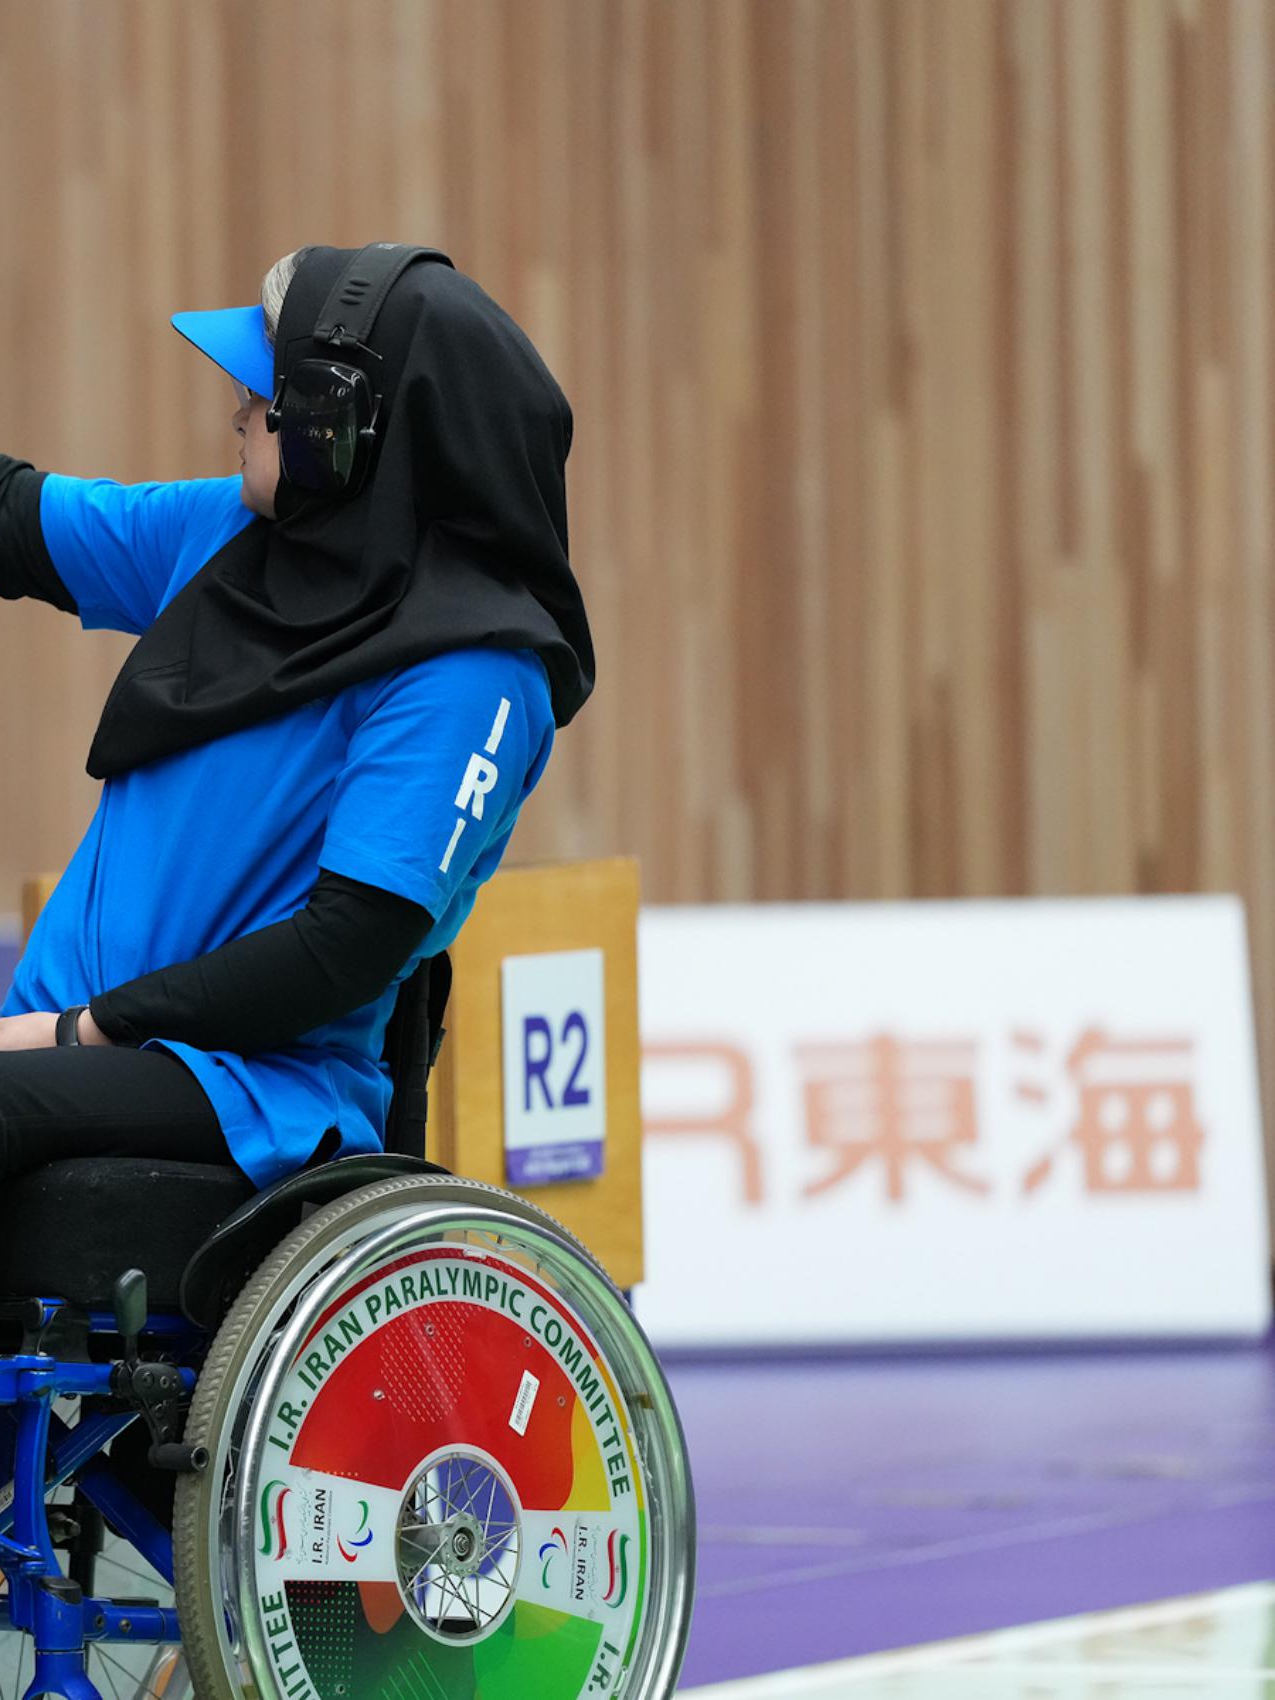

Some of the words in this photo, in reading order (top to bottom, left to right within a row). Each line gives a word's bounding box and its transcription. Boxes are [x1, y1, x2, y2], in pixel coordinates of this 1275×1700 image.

[522, 1010, 591, 1112] R2
[269, 1400, 307, 1451] I.R.
[297, 1311, 364, 1391] IRAN
[365, 1267, 525, 1324] PARALYMPIC
[530, 1305, 631, 1498] COMMITTEE
[313, 1488, 326, 1531] IRAN
[311, 1537, 324, 1564] I.R.
[577, 1526, 588, 1552] I.R.
[575, 1559, 587, 1601] IRAN
[261, 1591, 313, 1700] ITTEE
[588, 1641, 620, 1692] I.R.
